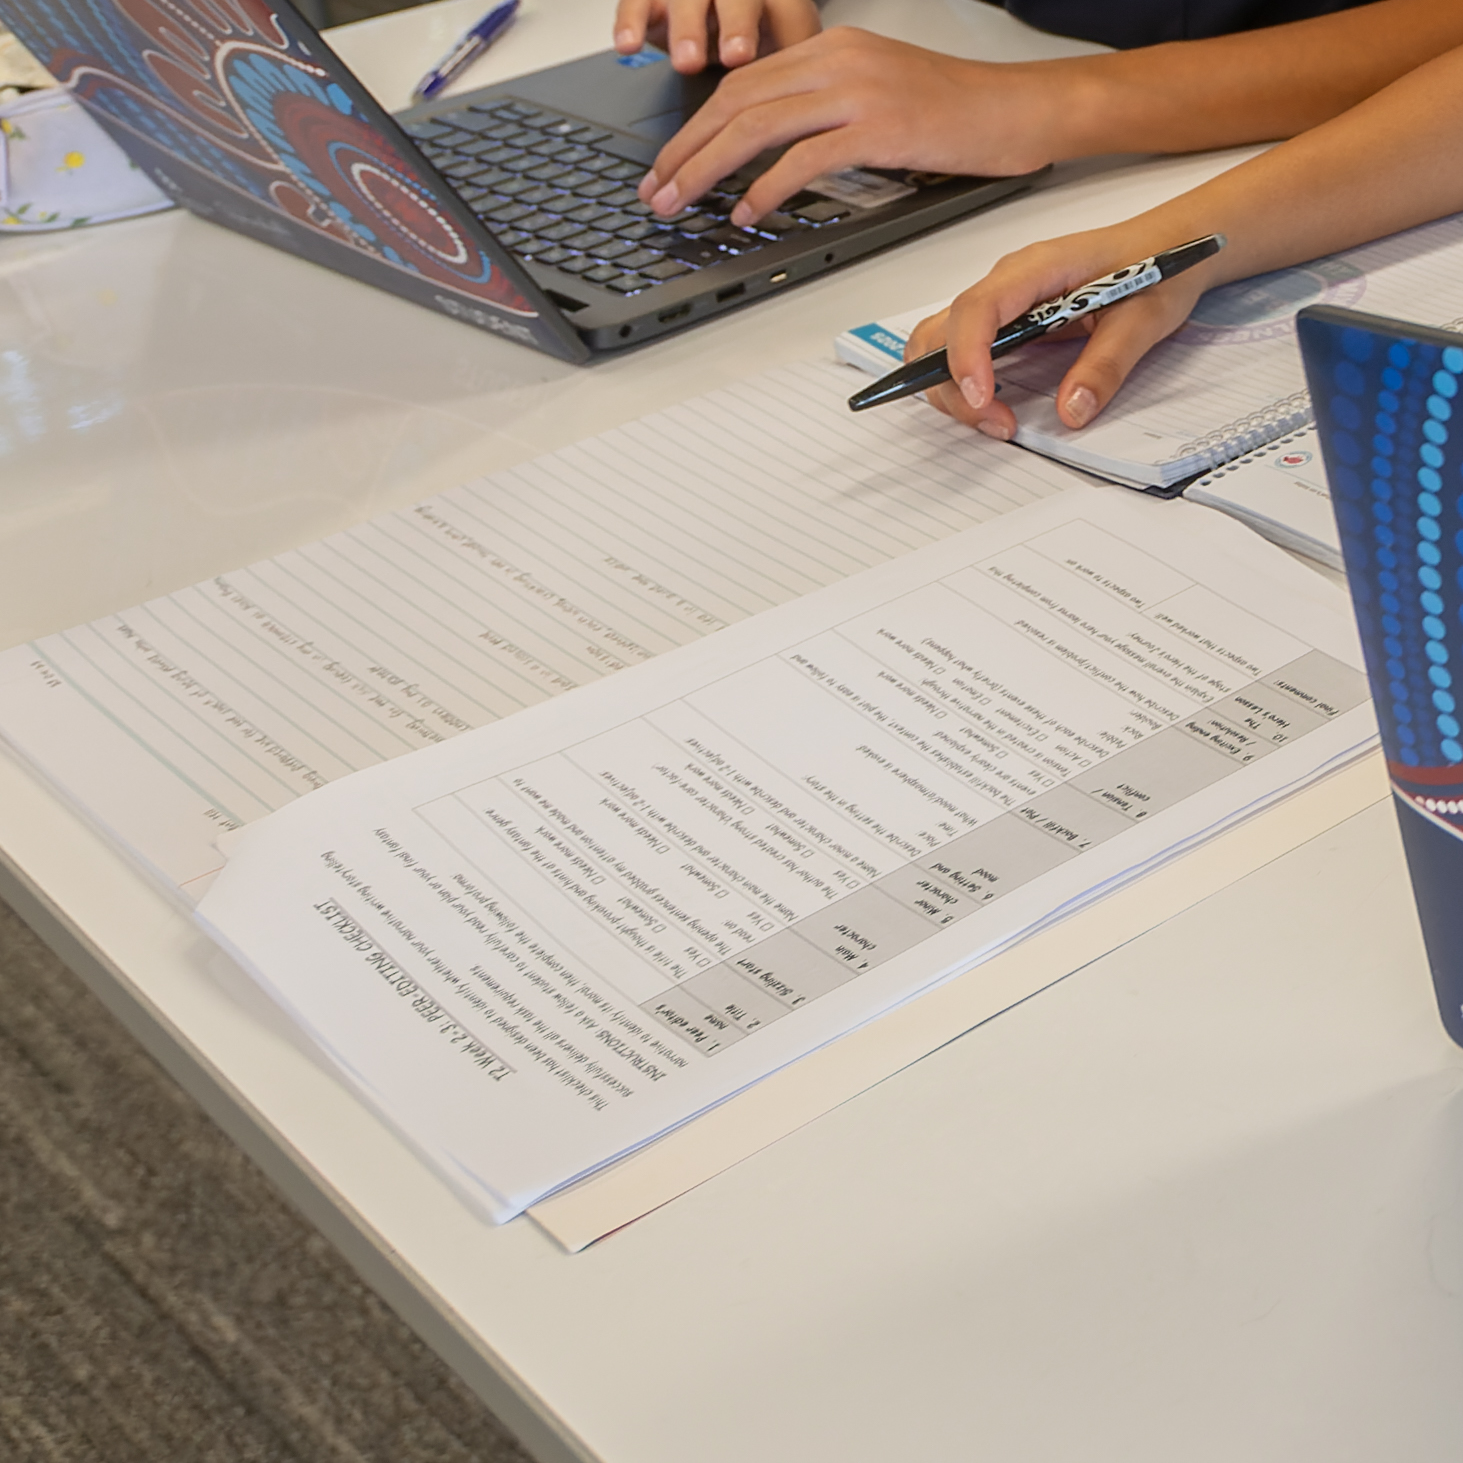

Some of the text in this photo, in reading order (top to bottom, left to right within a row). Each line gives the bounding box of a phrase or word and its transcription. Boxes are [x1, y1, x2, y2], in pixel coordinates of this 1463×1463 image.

[1231, 695, 1291, 728] Hero's Lesson
[1313, 701, 1341, 716] Final
[1183, 720, 1213, 738] ending
[1241, 716, 1263, 729] The
[1206, 733, 1242, 755] Exciting
[1099, 789, 1135, 811] Tension
[1115, 782, 1151, 803] conflict
[1018, 805, 1042, 819] Plot
[366, 826, 406, 853] fantasy
[660, 820, 699, 847] describe
[1042, 820, 1080, 841] Backfill
[391, 850, 420, 868] final
[690, 844, 712, 858] and
[409, 864, 437, 883] your
[610, 860, 630, 872] my
[703, 852, 748, 884] character
[929, 861, 952, 875] and
[970, 867, 1000, 884] mood
[425, 879, 443, 891] or
[620, 869, 661, 896] grabbed
[678, 861, 722, 892] Somewhat
[946, 870, 983, 893] Setting
[431, 886, 460, 905] plan
[565, 882, 590, 898] and
[739, 879, 764, 896] main
[913, 878, 960, 906] character
[648, 892, 692, 923] sentences
[756, 892, 777, 905] the
[911, 897, 942, 916] Minor
[447, 899, 476, 919] your
[479, 900, 525, 933] following
[614, 894, 660, 927] Somewhat
[744, 910, 767, 925] Yes
[769, 901, 800, 922] Name
[311, 898, 375, 953] CHECKLIST
[463, 915, 492, 935] read
[579, 893, 652, 948] thought-provoking
[511, 929, 534, 945] the
[683, 918, 722, 943] opening
[731, 926, 757, 944] read
[831, 922, 878, 952] character
[480, 930, 522, 965] carefully
[525, 940, 569, 973] complete
[641, 944, 658, 954] is
[681, 945, 704, 960] Yes
[710, 939, 734, 955] The
[831, 944, 860, 962] Main
[511, 960, 531, 972] to
[648, 950, 674, 967] title
[733, 957, 763, 976] start
[316, 849, 611, 1111] This checklist has been designed to identify whether your narrative writing storytelling
[555, 968, 582, 987] then
[664, 962, 690, 979] The
[363, 949, 447, 1022] PEER-EDITING
[520, 968, 558, 996] student
[755, 970, 795, 997] Sizzling
[547, 991, 580, 1014] fellow
[572, 982, 606, 1006] moral,
[572, 1009, 587, 1018] a
[595, 1001, 616, 1014] its
[650, 1002, 691, 1029] editor's
[721, 1002, 750, 1021] Title
[465, 962, 636, 1099] successfully delivers all the task requirements.
[575, 1014, 601, 1031] Ask
[607, 1008, 647, 1037] identify
[701, 1012, 730, 1031] name
[636, 1032, 654, 1043] to
[681, 1024, 710, 1043] Peer
[457, 1039, 497, 1069] Week
[645, 1039, 690, 1070] narrative
[486, 1064, 512, 1082] T2
